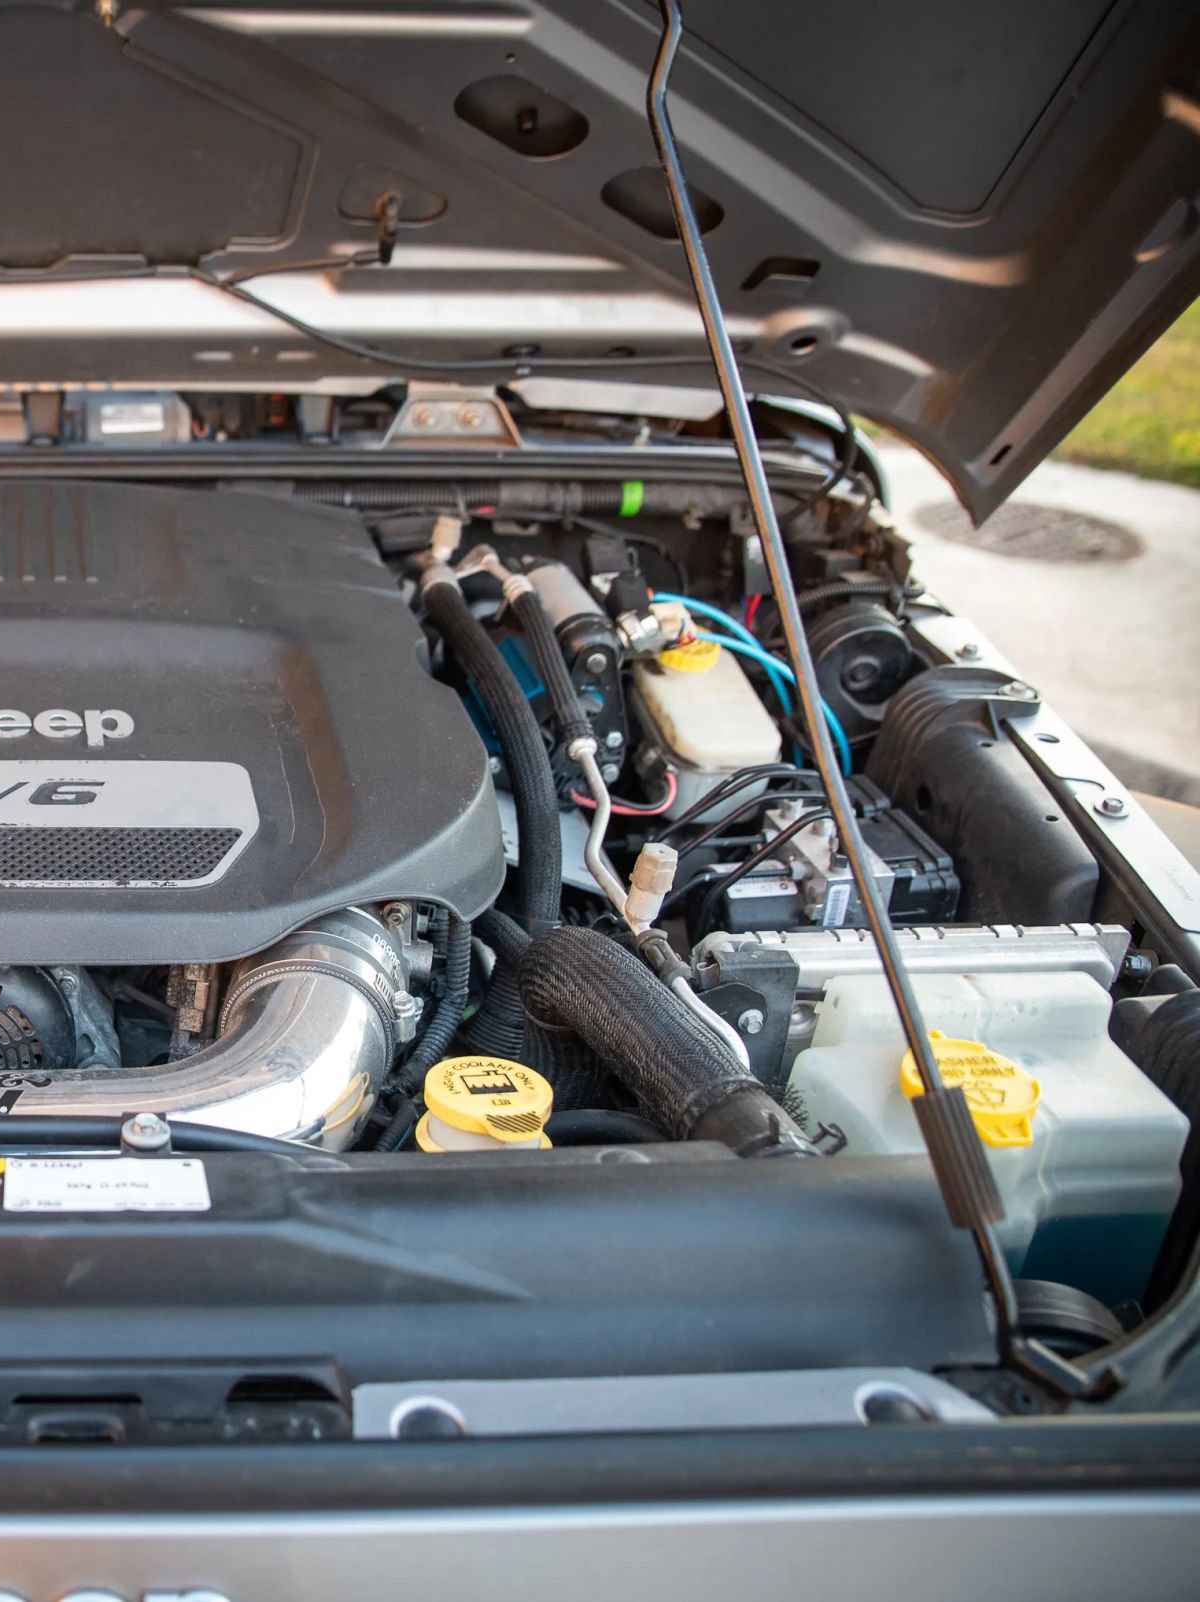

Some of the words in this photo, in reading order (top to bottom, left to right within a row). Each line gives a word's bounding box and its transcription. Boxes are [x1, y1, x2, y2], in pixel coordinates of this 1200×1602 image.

[936, 1056, 997, 1066] ASHER
[452, 1061, 514, 1071] COOLANT
[515, 1072, 535, 1091] ONLY
